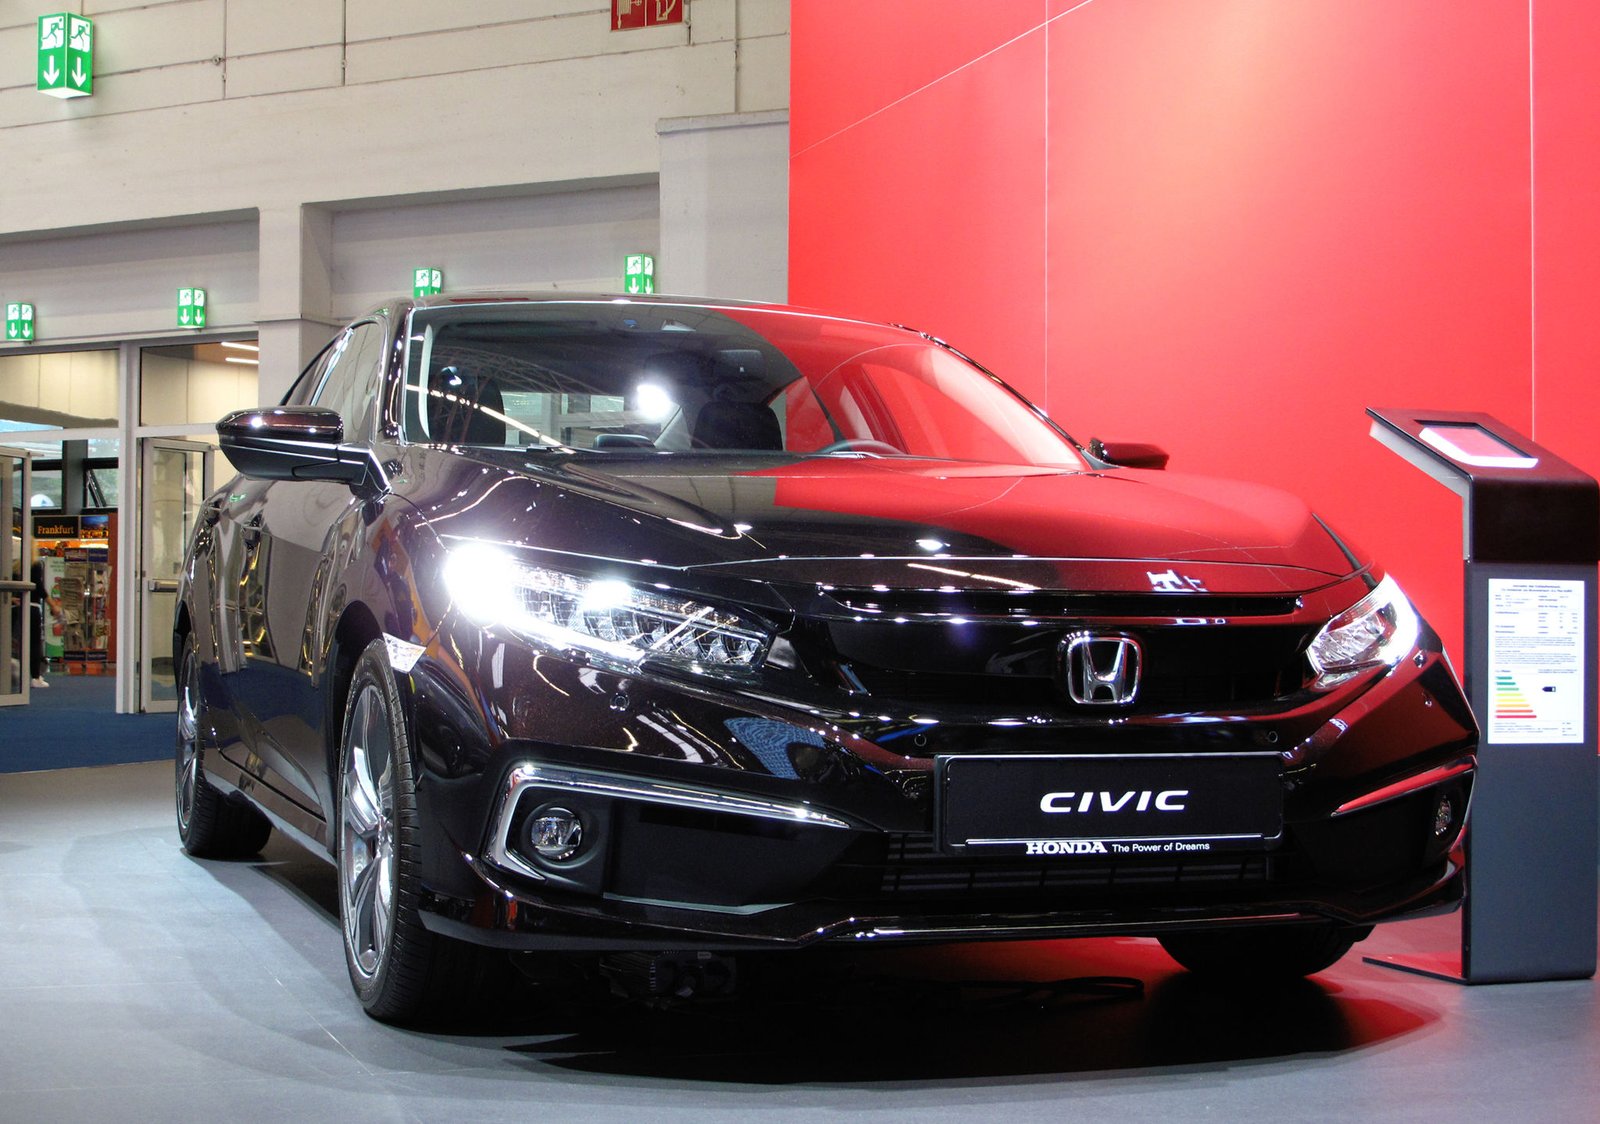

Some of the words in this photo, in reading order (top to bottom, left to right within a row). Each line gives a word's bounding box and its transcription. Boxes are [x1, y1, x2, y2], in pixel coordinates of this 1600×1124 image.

[37, 525, 74, 535] Frankfurt
[1039, 789, 1190, 814] CIVIC
[1025, 840, 1108, 855] HONDA
[1111, 843, 1130, 853] The
[1132, 843, 1162, 853] Power
[1163, 842, 1173, 852] of
[1175, 841, 1211, 851] Dreams
